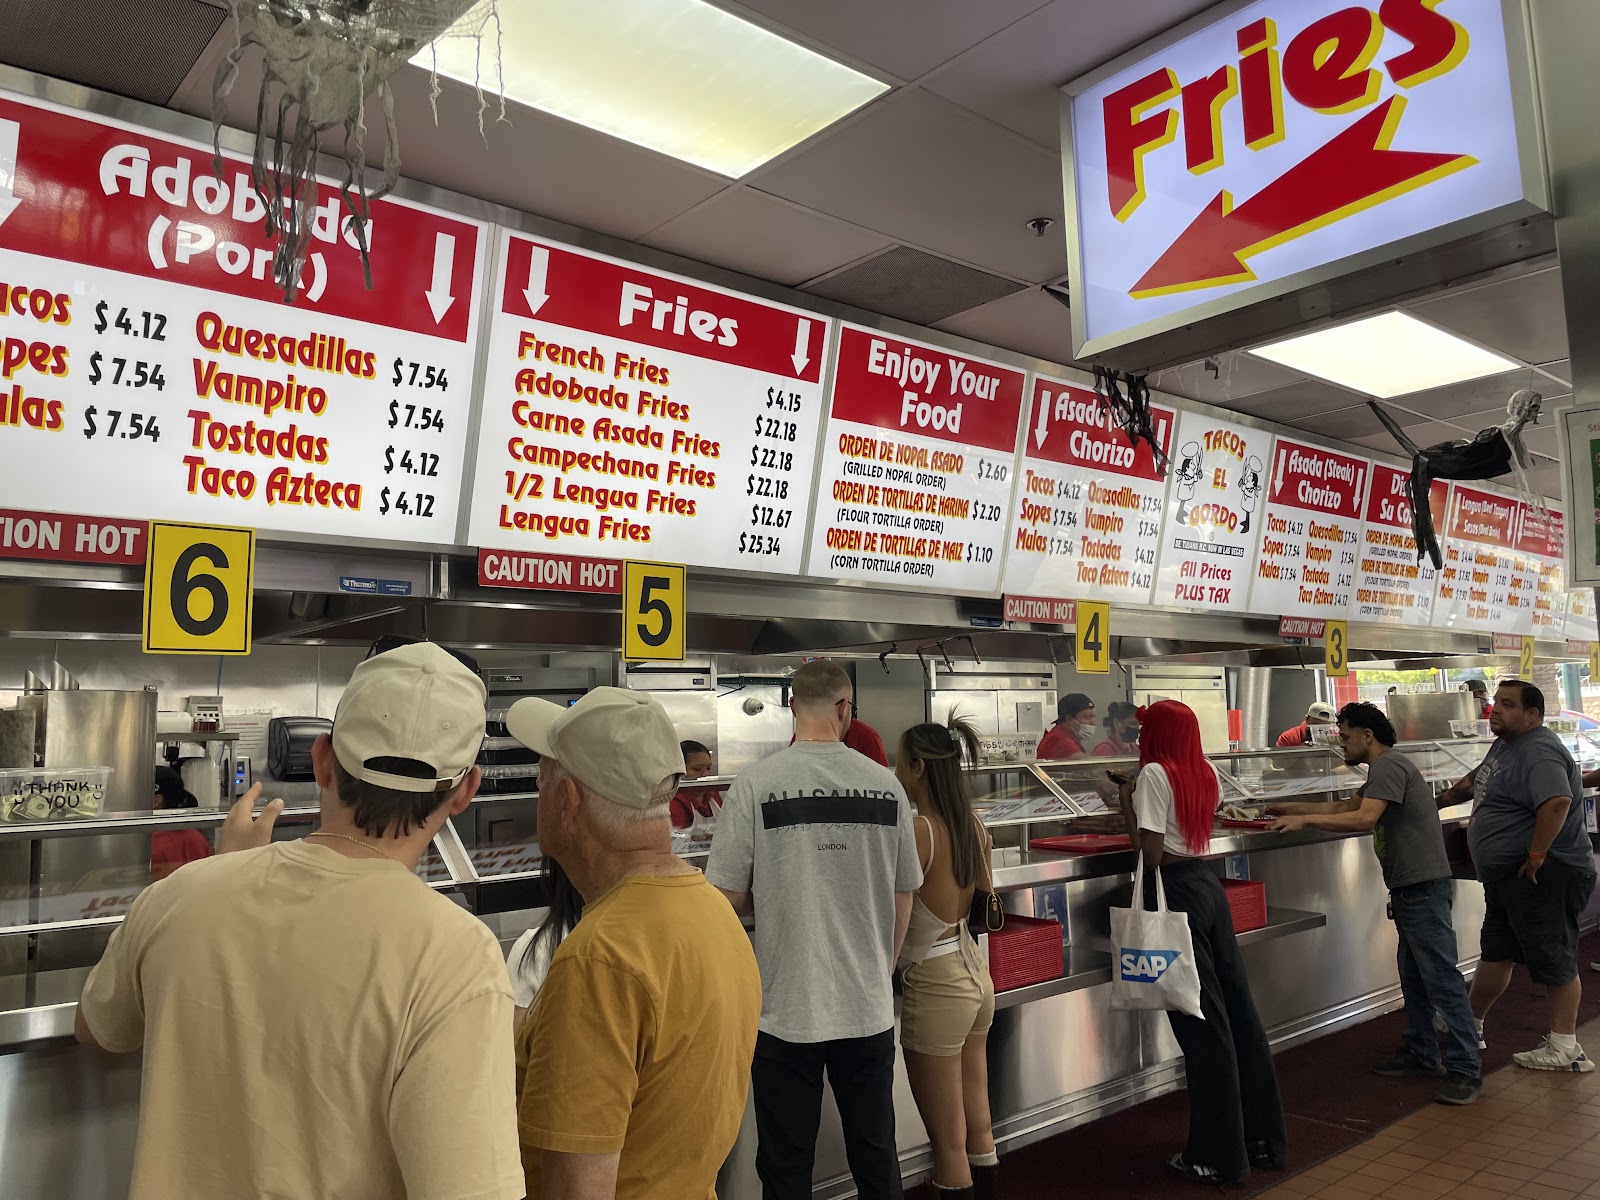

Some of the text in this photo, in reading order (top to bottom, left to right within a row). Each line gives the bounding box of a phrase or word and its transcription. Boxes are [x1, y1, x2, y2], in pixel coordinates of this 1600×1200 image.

[1102, 0, 1470, 224] Fries
[147, 214, 328, 303] (Por)
[619, 281, 738, 348] Fries
[0, 336, 69, 380] pes
[195, 310, 377, 380] Quesadillas
[518, 331, 606, 373] French
[613, 352, 669, 386] Fries
[867, 339, 1000, 401] Enjoy Your
[192, 359, 327, 417] Vampiro
[515, 368, 630, 411] Adobada
[637, 391, 690, 421] Fries
[901, 391, 962, 434] Food
[187, 409, 329, 464] Tostadas
[511, 401, 586, 436] Carne
[592, 419, 665, 449] Asada
[671, 430, 721, 458] Fries
[839, 433, 878, 461] ORDEN
[879, 440, 894, 463] DE
[895, 443, 930, 470] NOPAL
[931, 450, 964, 475] ASADO
[1070, 430, 1135, 469] Chorizo
[1203, 429, 1247, 461] TACOS
[508, 438, 660, 481] Campechana
[666, 461, 716, 488] Fries
[843, 461, 946, 491] (GRILLED NOPAL ORDER)
[1288, 450, 1354, 486] Asada (Steak)
[182, 455, 256, 500] Taco
[266, 467, 362, 510] Azteca
[504, 471, 544, 501] 1/2
[553, 478, 639, 511] Lengua
[646, 490, 697, 516] Fries
[1026, 470, 1055, 496] Tacos
[1213, 467, 1228, 490] EL
[833, 480, 865, 505] ORDEN
[867, 485, 879, 505] DE
[882, 486, 924, 513] TORTILLAS
[925, 494, 937, 513] DE
[938, 496, 969, 520] HARINA
[1088, 481, 1140, 510] Quesadillas
[1298, 480, 1342, 510] Chorizo
[1379, 499, 1394, 520] Su
[499, 504, 590, 538] Lengua
[598, 516, 651, 542] Fries
[837, 508, 944, 535] (FLOUR TORTILLA ORDER)
[1020, 498, 1052, 527] Sopes
[1084, 507, 1123, 535] Vampiro
[1189, 503, 1238, 533] GORDO
[1267, 513, 1286, 533] Tacos
[75, 523, 140, 555] HOT
[827, 528, 862, 553] ORDEN
[864, 532, 878, 552] DE
[880, 534, 927, 559] TORTILLAS
[928, 540, 940, 558] DE
[1016, 528, 1048, 552] Mulas
[1309, 520, 1344, 543] Quesadillas
[1080, 536, 1121, 561] Tostadas
[1263, 536, 1284, 559] Sopes
[1306, 542, 1332, 564] Vampiro
[484, 555, 618, 588] CAUTION HOT
[830, 555, 934, 578] (CORN TORTILLA ORDER)
[1077, 561, 1097, 583] Taco
[1100, 564, 1129, 587] Azteca
[1180, 560, 1231, 581] All Prices
[1258, 559, 1280, 579] Mulas
[1302, 565, 1329, 584] Tostadas
[170, 543, 230, 636] 6
[1175, 584, 1231, 604] PLUS TAX
[1298, 586, 1312, 603] Taco
[637, 576, 672, 646] 5
[1007, 599, 1074, 620] CAUTION HOT
[1084, 612, 1102, 662] 4
[1282, 620, 1324, 634] CAUTION HOT
[1331, 628, 1342, 669] 3
[1522, 642, 1531, 674] 2
[1593, 648, 1598, 676] 1
[26, 780, 90, 793] THANK
[46, 794, 79, 809] YOU
[1122, 954, 1167, 977] SAP
